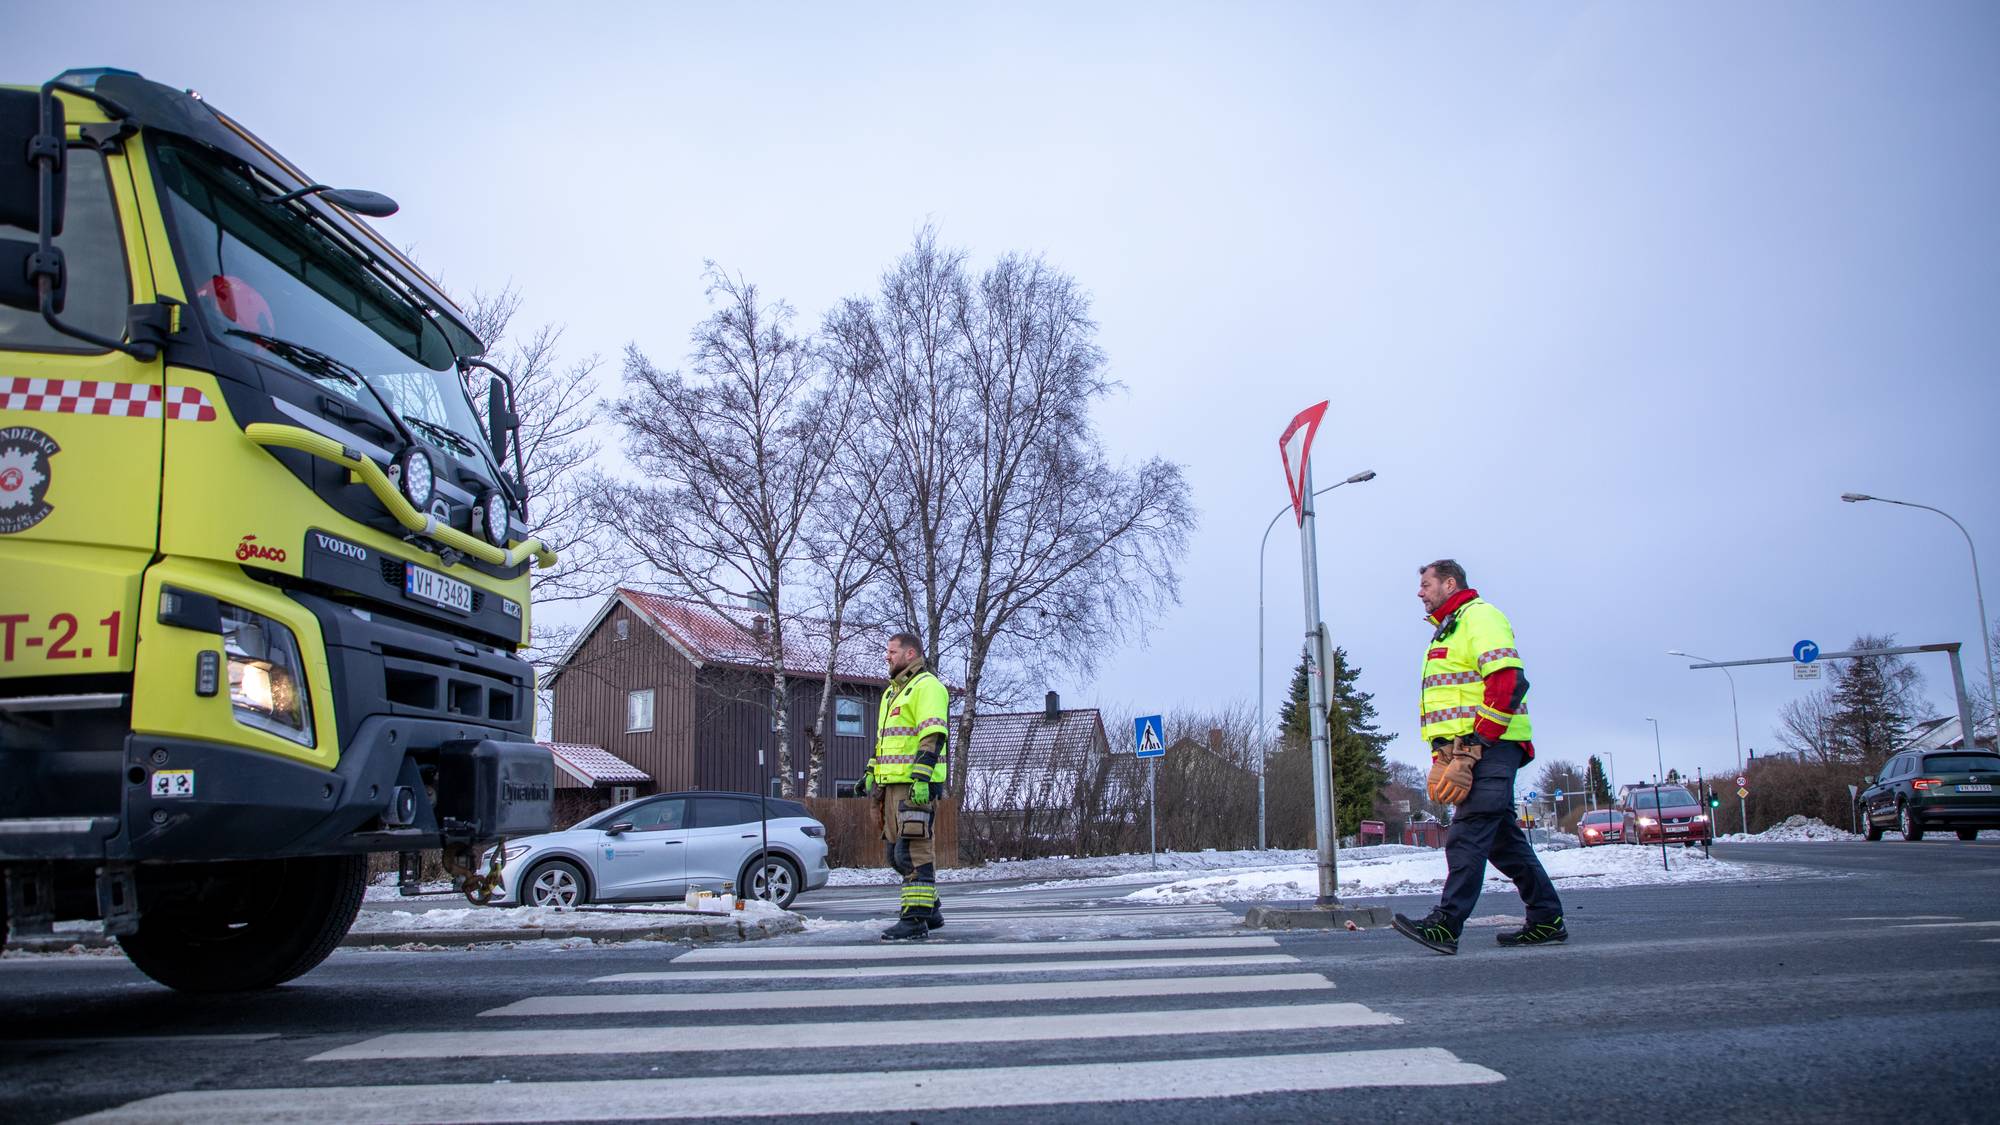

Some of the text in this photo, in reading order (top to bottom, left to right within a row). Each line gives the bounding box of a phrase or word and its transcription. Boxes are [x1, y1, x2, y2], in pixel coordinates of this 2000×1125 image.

[315, 533, 367, 561] VOLVO
[416, 569, 470, 609] VH 73482
[0, 610, 120, 662] T-2.1
